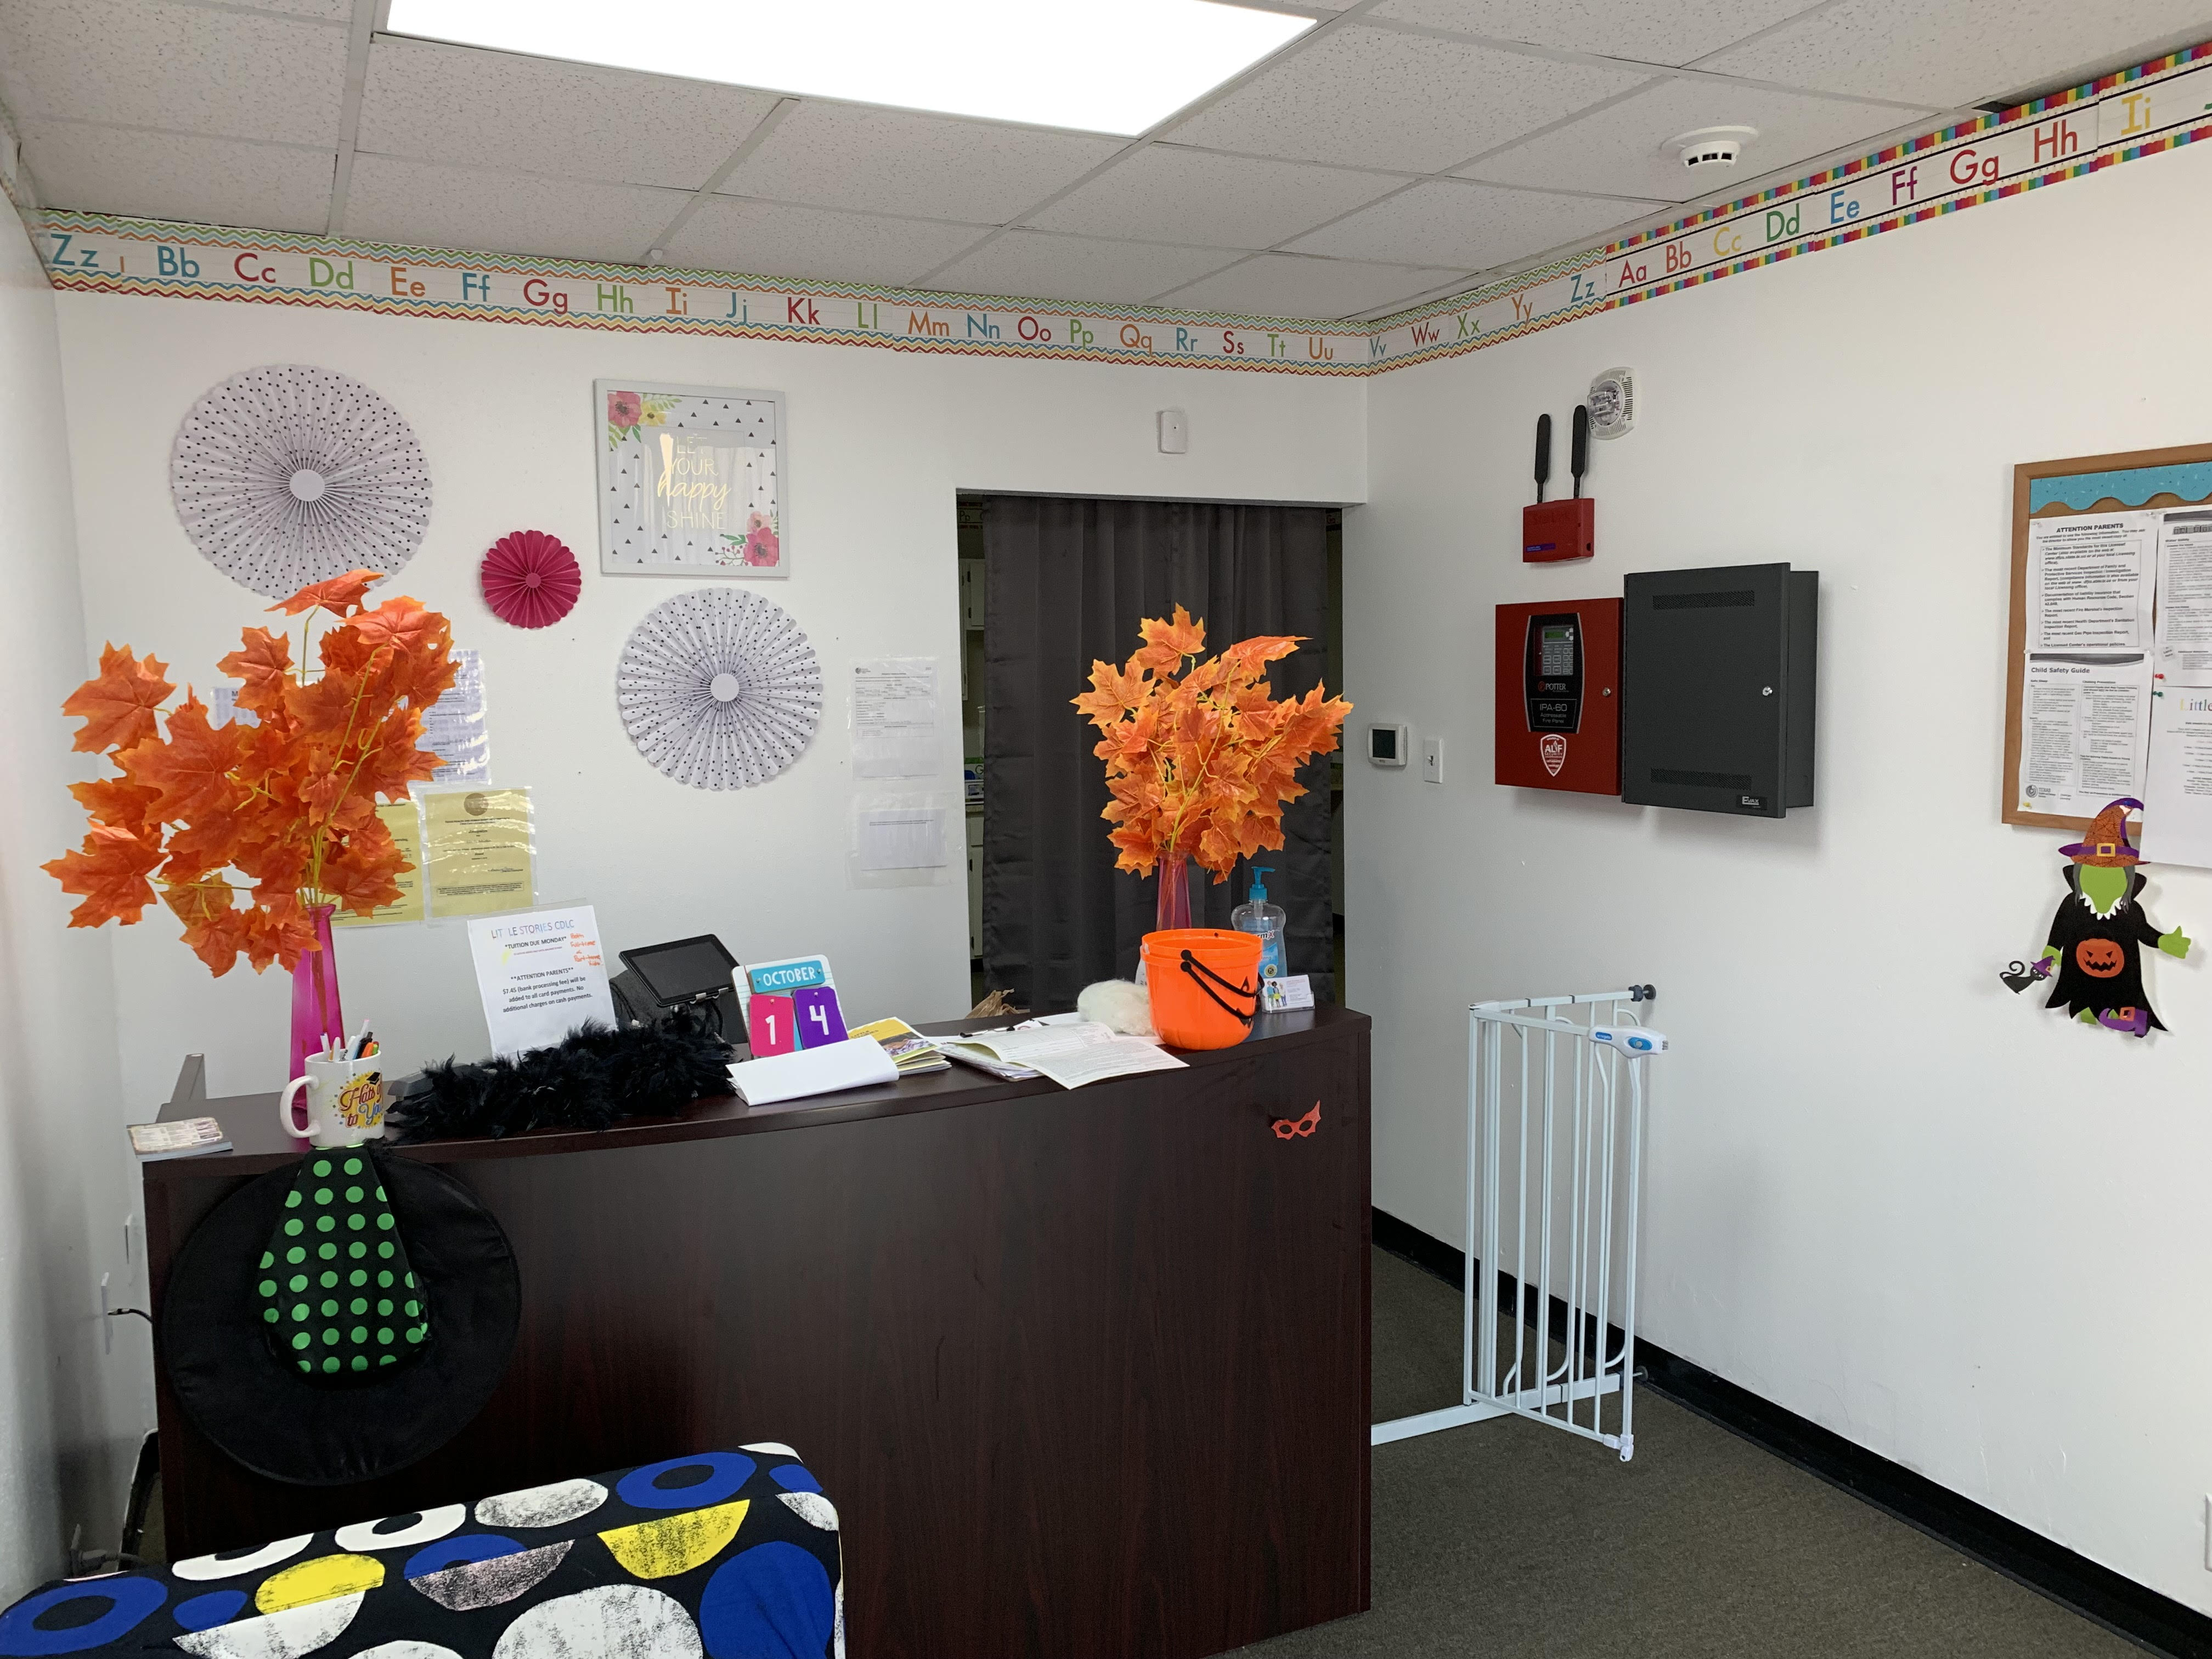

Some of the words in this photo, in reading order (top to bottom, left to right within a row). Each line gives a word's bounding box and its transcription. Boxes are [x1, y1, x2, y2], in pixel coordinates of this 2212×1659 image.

[1618, 259, 1646, 288] Aa
[1666, 241, 1692, 274] Bb
[1713, 227, 1742, 257] Cc
[1766, 203, 1801, 242] Dd
[1831, 189, 1860, 224] Ee
[1891, 166, 1917, 206] Ff
[1950, 148, 2000, 185] Gg
[2033, 121, 2078, 164] Hh
[2121, 93, 2151, 136] Ii
[50, 233, 99, 268] Zz
[157, 245, 200, 278] Bb
[234, 252, 276, 284] Cc
[310, 257, 354, 290] Dd
[391, 267, 426, 297] Ee
[462, 272, 490, 302] Ff
[523, 278, 568, 314] Gg
[597, 283, 634, 313] Hh
[665, 287, 687, 315] Ii
[726, 292, 747, 326] Jj
[787, 297, 821, 325] Kk
[858, 302, 877, 329] Ll
[908, 311, 950, 336] Mm
[967, 313, 1000, 339] Nn
[1018, 315, 1052, 342] Oo
[1070, 319, 1094, 350] Pp
[1120, 324, 1153, 357] Qq
[1176, 328, 1198, 352] Rr
[1223, 331, 1244, 354] Ss
[1267, 334, 1285, 357] Tt
[1309, 337, 1333, 360] Uu
[1370, 336, 1386, 358] Vv
[1411, 323, 1440, 347] Ww
[1457, 313, 1481, 340] Xx
[1511, 294, 1533, 329] Yy
[1570, 274, 1595, 303] Zz
[676, 436, 707, 454] LET
[657, 469, 732, 512] happy
[667, 510, 725, 529] SHINE
[492, 927, 518, 939] LITLE
[520, 923, 552, 934] STORIES
[555, 920, 575, 929] CDLC
[533, 981, 558, 990] processing
[763, 966, 816, 987] OCTOBER
[551, 988, 575, 996] payments.
[503, 1004, 528, 1013] additional
[568, 994, 592, 1002] payments.
[765, 1015, 776, 1045] 1
[809, 1005, 830, 1035] 4
[340, 1083, 375, 1111] Hats
[358, 1101, 381, 1126] Yo
